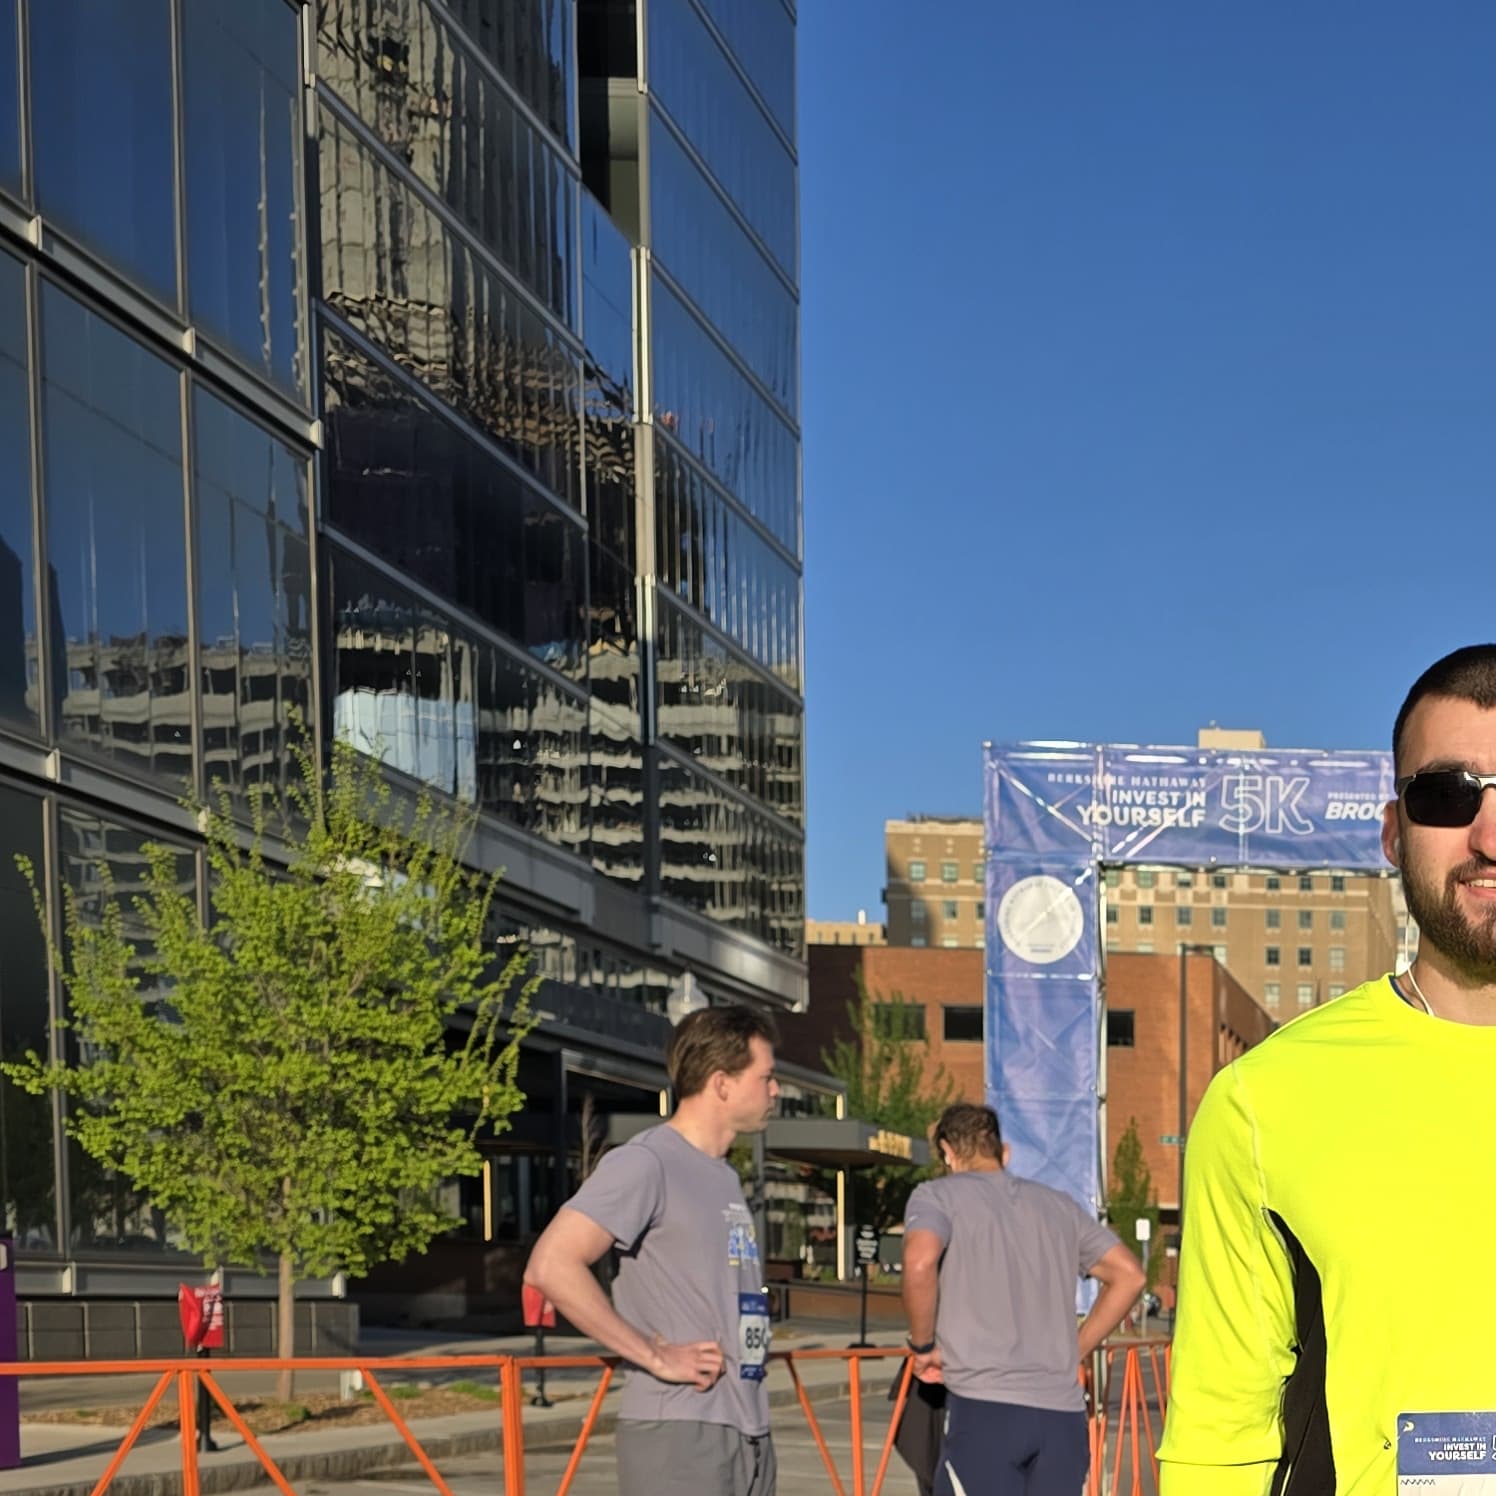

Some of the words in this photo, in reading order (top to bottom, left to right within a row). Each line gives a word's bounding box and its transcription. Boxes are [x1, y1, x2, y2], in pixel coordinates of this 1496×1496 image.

[1112, 789, 1180, 806] INVEST
[1185, 791, 1206, 807] IN
[1218, 775, 1315, 835] 5K
[1076, 804, 1206, 828] YOURSELF
[1428, 1450, 1487, 1461] YOURSELF
[1443, 1442, 1476, 1451] INVEST
[1476, 1442, 1487, 1450] IN
